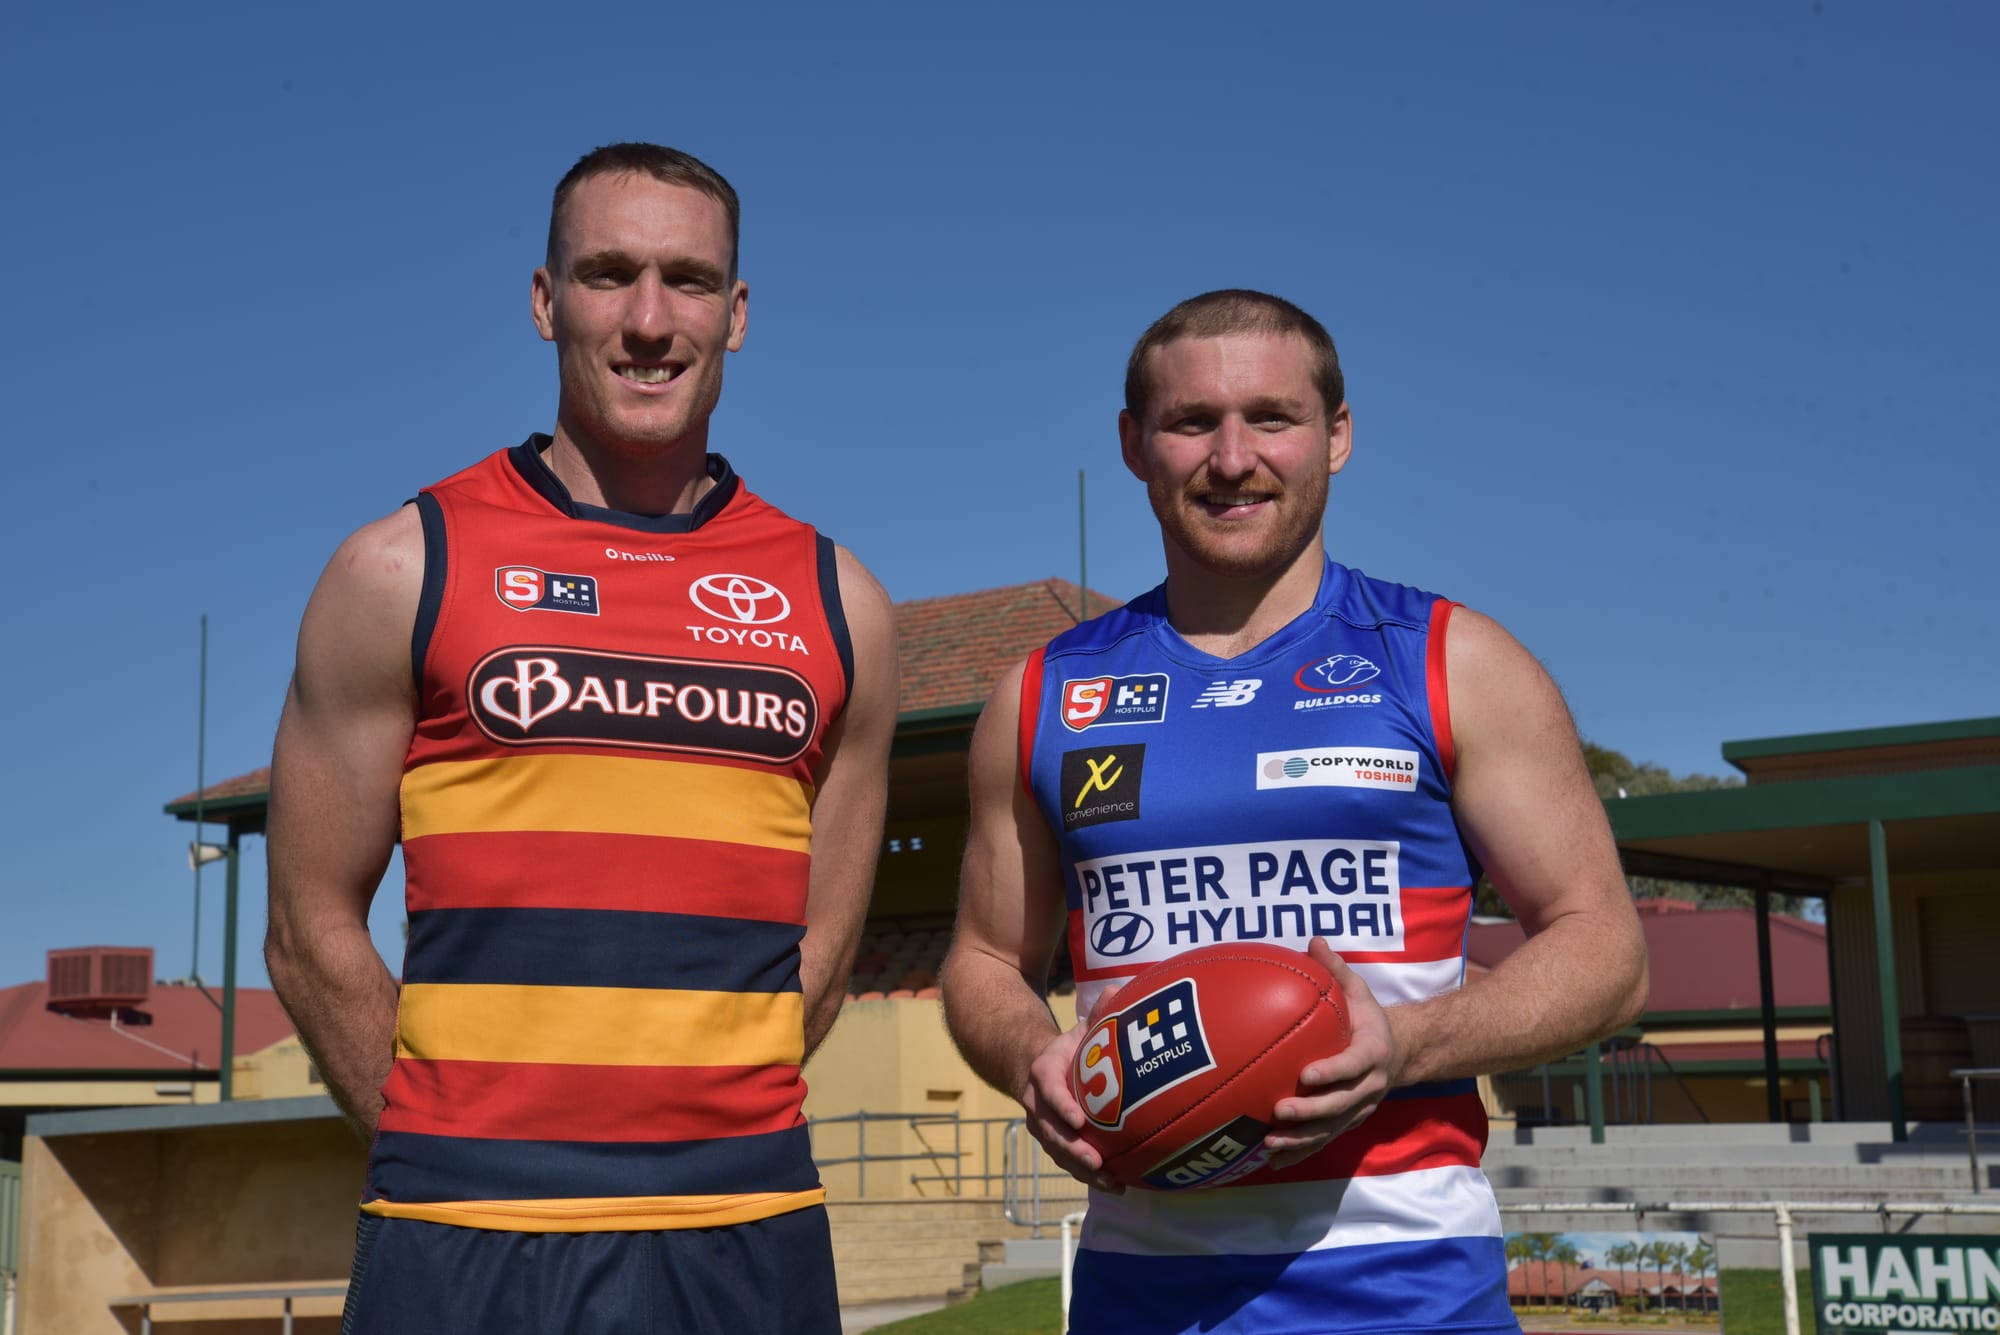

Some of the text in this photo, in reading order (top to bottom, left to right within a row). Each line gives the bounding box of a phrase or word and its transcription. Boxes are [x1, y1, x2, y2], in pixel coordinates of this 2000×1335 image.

[553, 598, 590, 606] HOSTPLUS
[686, 626, 809, 655] TOYOTA
[480, 658, 807, 738] BALFOURS
[1115, 706, 1156, 714] HOSTPLUS
[1294, 694, 1382, 710] BULLDOGS
[1310, 757, 1414, 771] COPYWORLD
[1354, 770, 1413, 783] TOSHIBA
[1065, 801, 1134, 822] convenience
[1082, 848, 1389, 914] PETER PAGE
[1168, 903, 1394, 945] HYUNDAI
[1135, 1041, 1193, 1078] HOSTPLUS
[1165, 1135, 1248, 1185] END
[1821, 1246, 2000, 1302] HAHN
